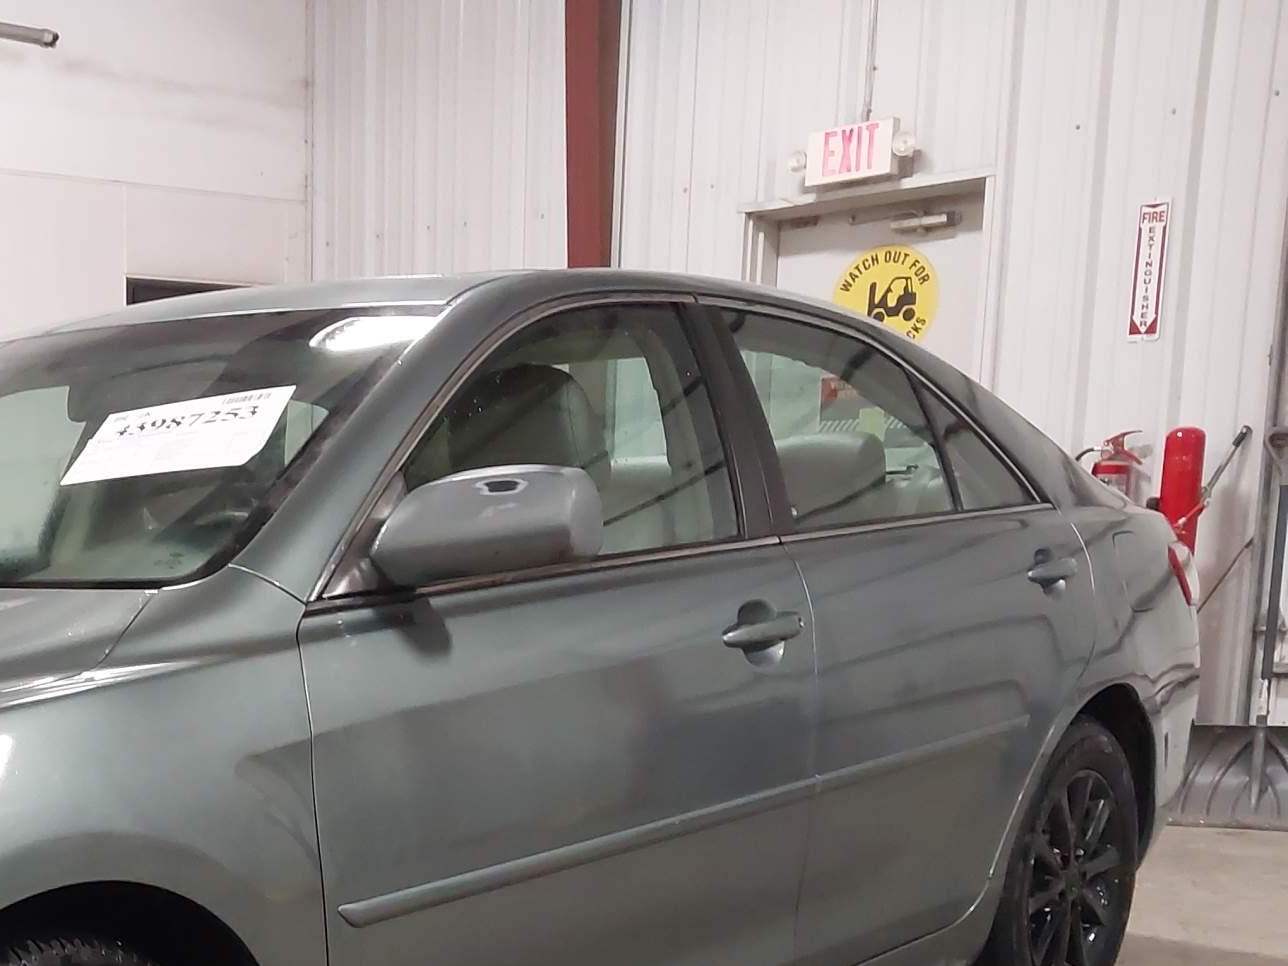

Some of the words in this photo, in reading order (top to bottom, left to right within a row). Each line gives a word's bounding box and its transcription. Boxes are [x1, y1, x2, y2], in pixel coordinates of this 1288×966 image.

[822, 123, 880, 177] EXIT
[1142, 210, 1165, 224] FIRE
[840, 253, 880, 292] WATCH
[884, 250, 910, 266] OUT
[908, 259, 930, 285] FOR
[1139, 226, 1156, 328] EXTINGUISHER
[906, 317, 927, 340] CKS
